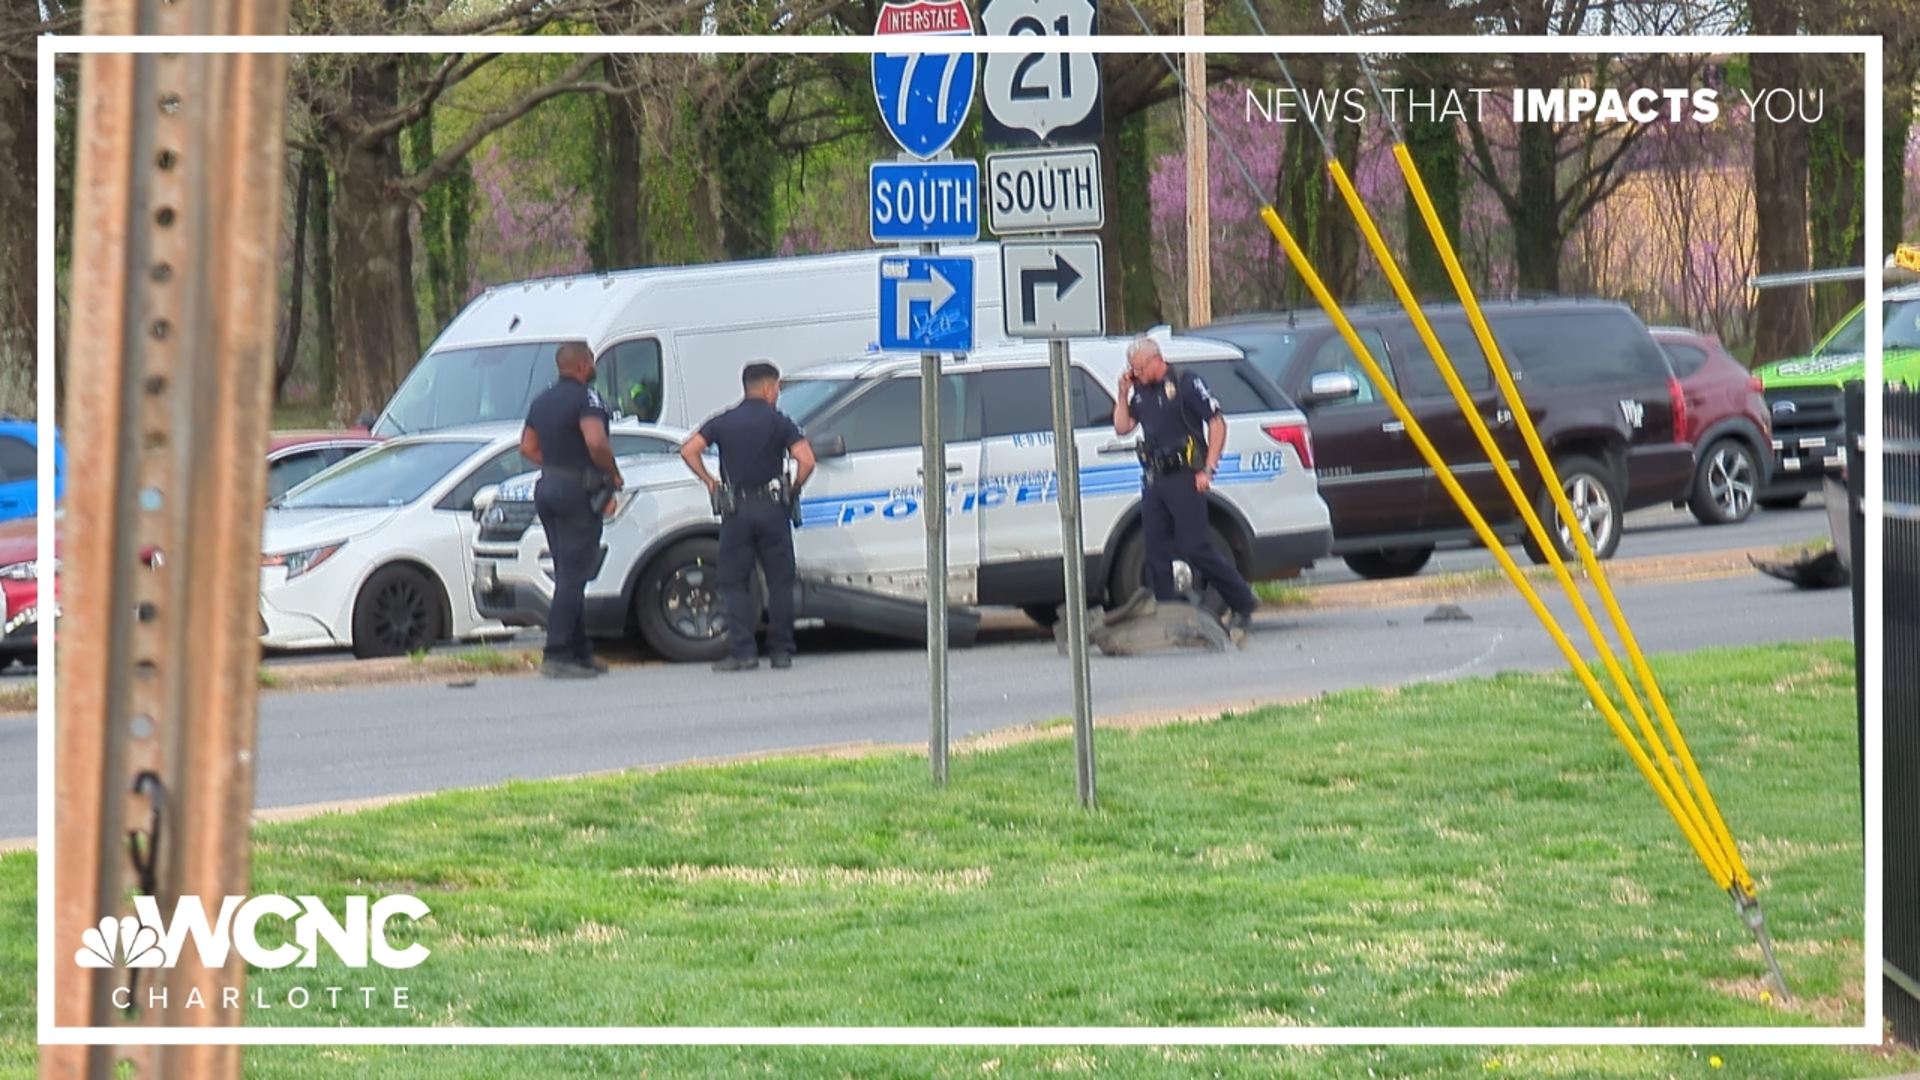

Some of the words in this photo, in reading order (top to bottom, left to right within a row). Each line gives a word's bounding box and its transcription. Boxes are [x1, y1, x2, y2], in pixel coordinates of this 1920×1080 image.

[887, 9, 958, 31] INTERSTATE
[1008, 15, 1072, 101] 21
[886, 44, 961, 125] 77
[876, 179, 972, 224] SOUTH
[995, 166, 1092, 213] SOUTH
[840, 484, 1045, 526] POICE
